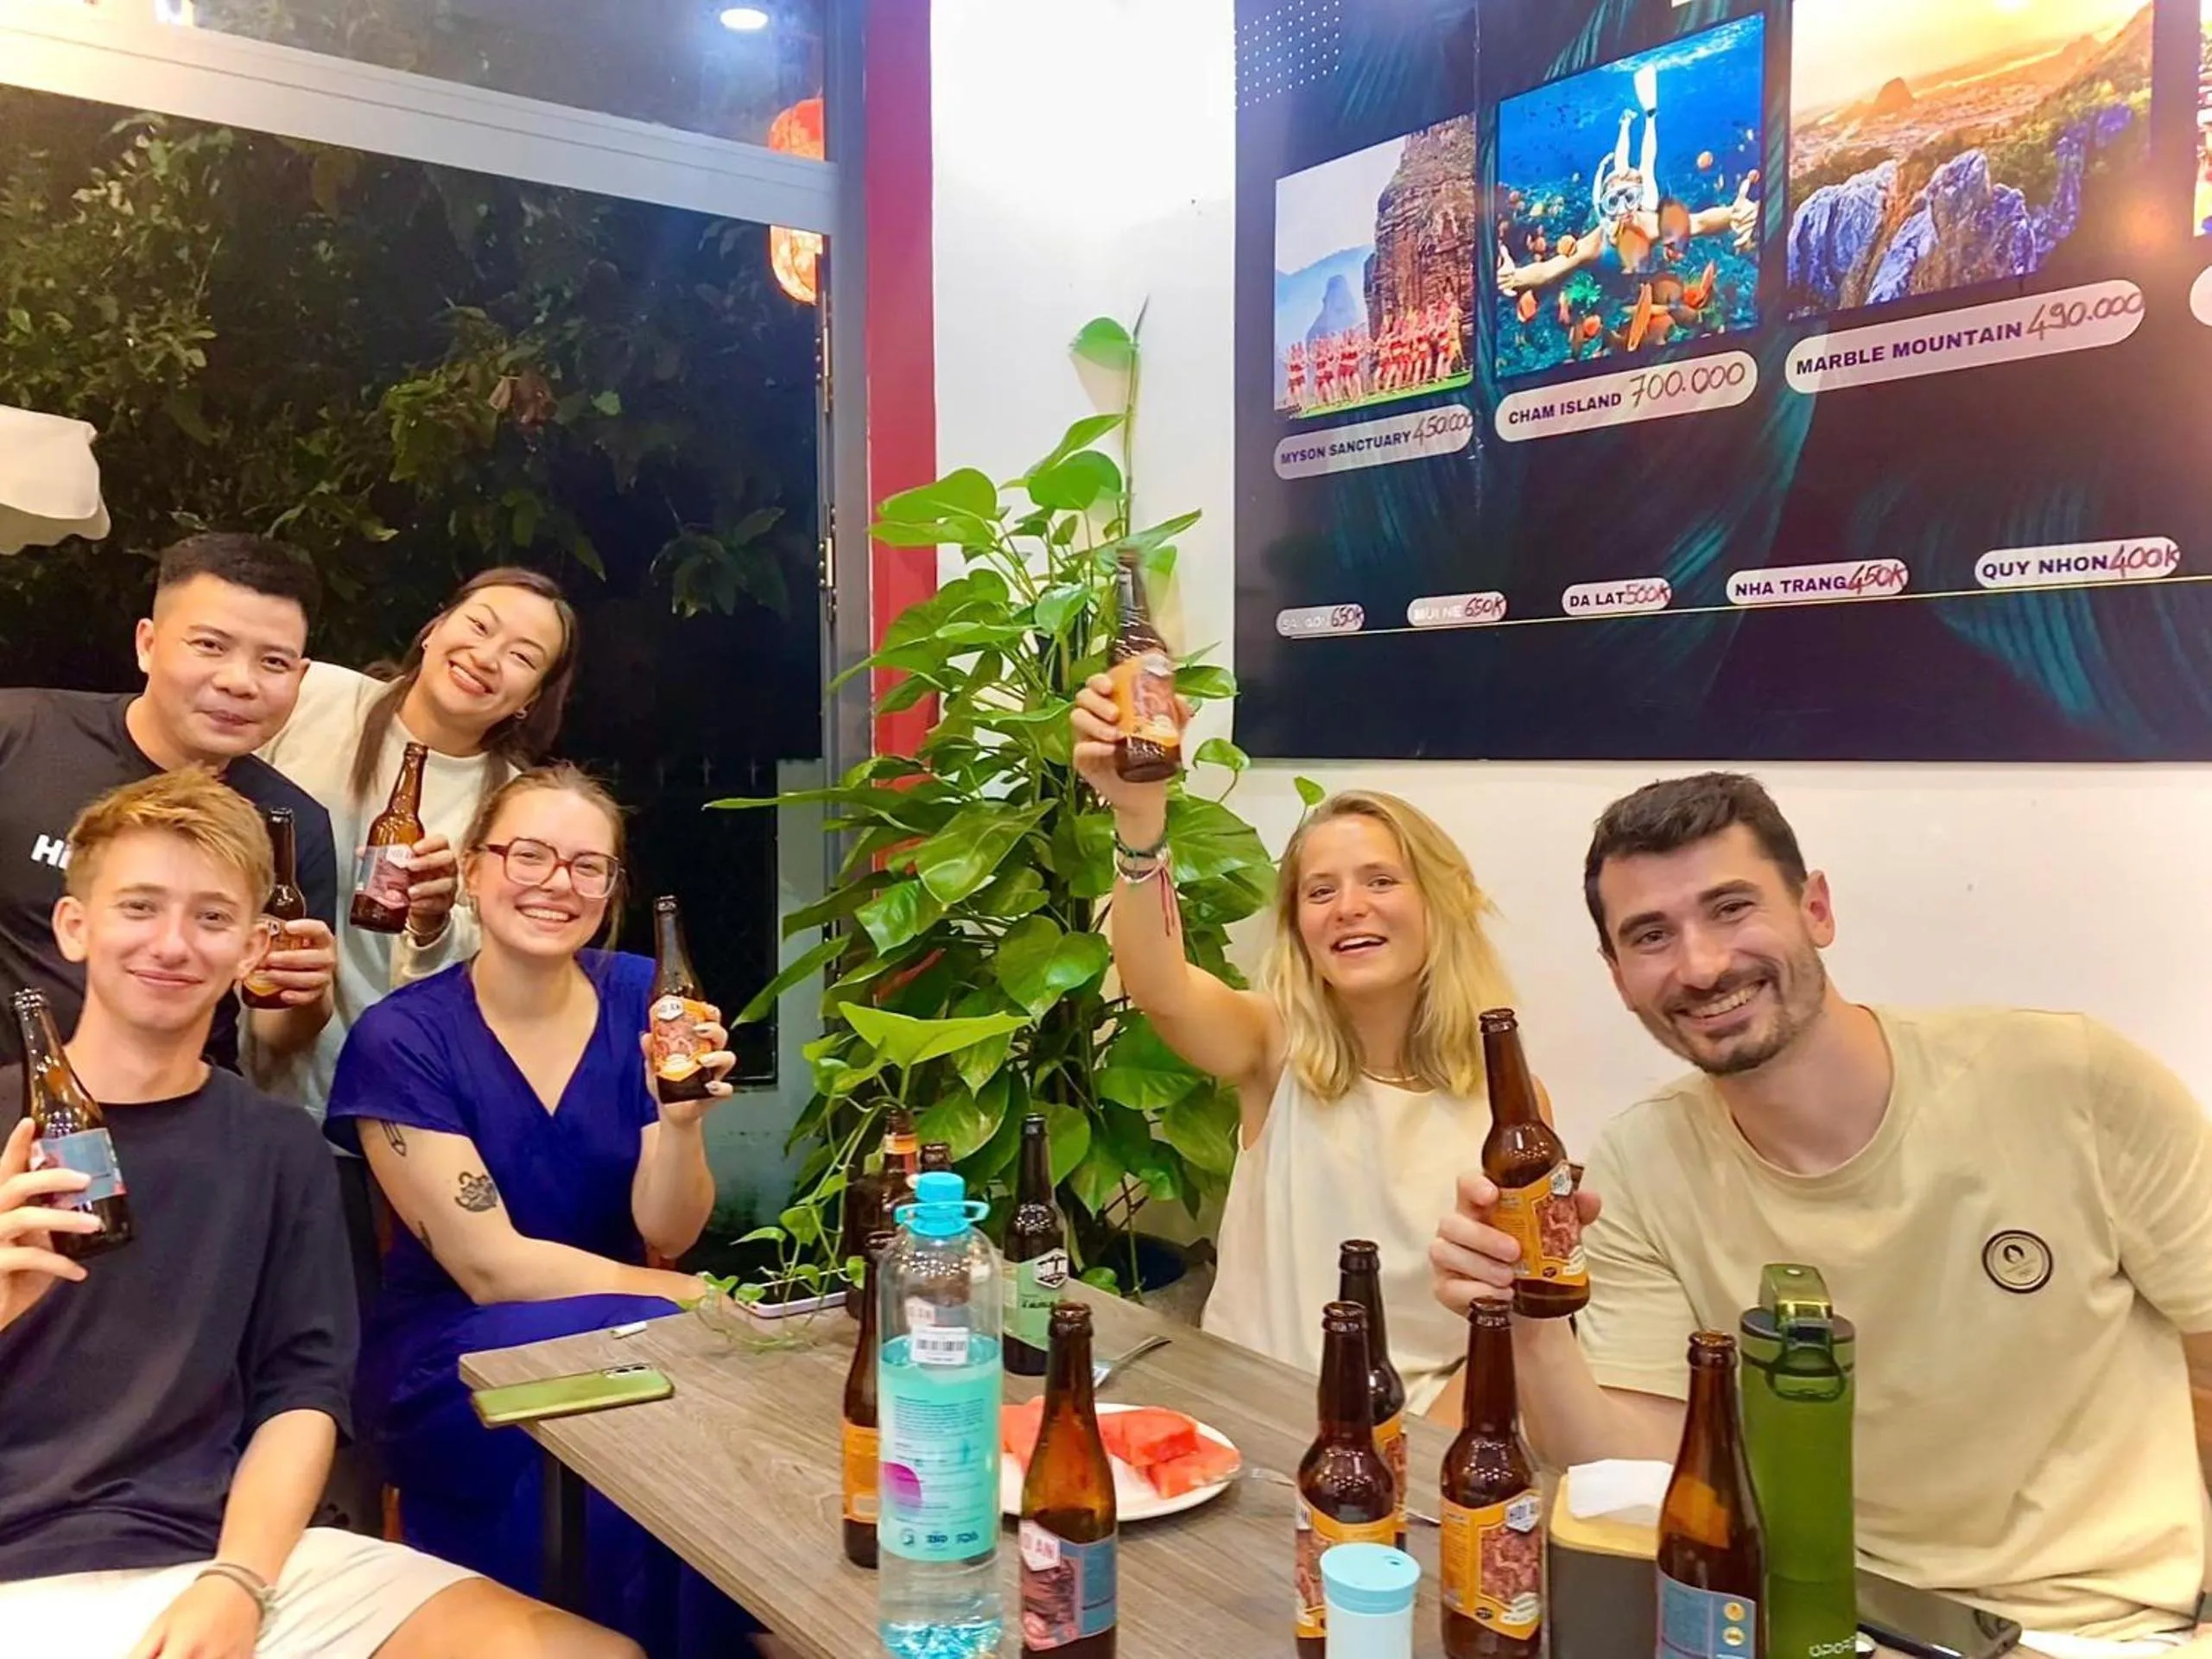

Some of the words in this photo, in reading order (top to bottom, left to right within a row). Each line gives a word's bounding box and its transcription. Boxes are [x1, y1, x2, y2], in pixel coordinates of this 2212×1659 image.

[2025, 292, 2145, 341] 490.000
[1796, 345, 1886, 377] MARBLE
[1892, 320, 2023, 360] MOUNTAIN
[1629, 361, 1746, 408] 700.000
[1508, 404, 1556, 425] CHAM
[1559, 392, 1622, 415] ISLAND
[1280, 445, 1327, 465] MYSON
[1329, 430, 1411, 457] SANCTUARY
[1981, 559, 2031, 580] QUY
[2038, 553, 2108, 576] NHON
[1569, 594, 1591, 608] DA
[1595, 591, 1625, 606] LAT
[1734, 581, 1774, 597] NHA
[1779, 576, 1848, 594] TRANG
